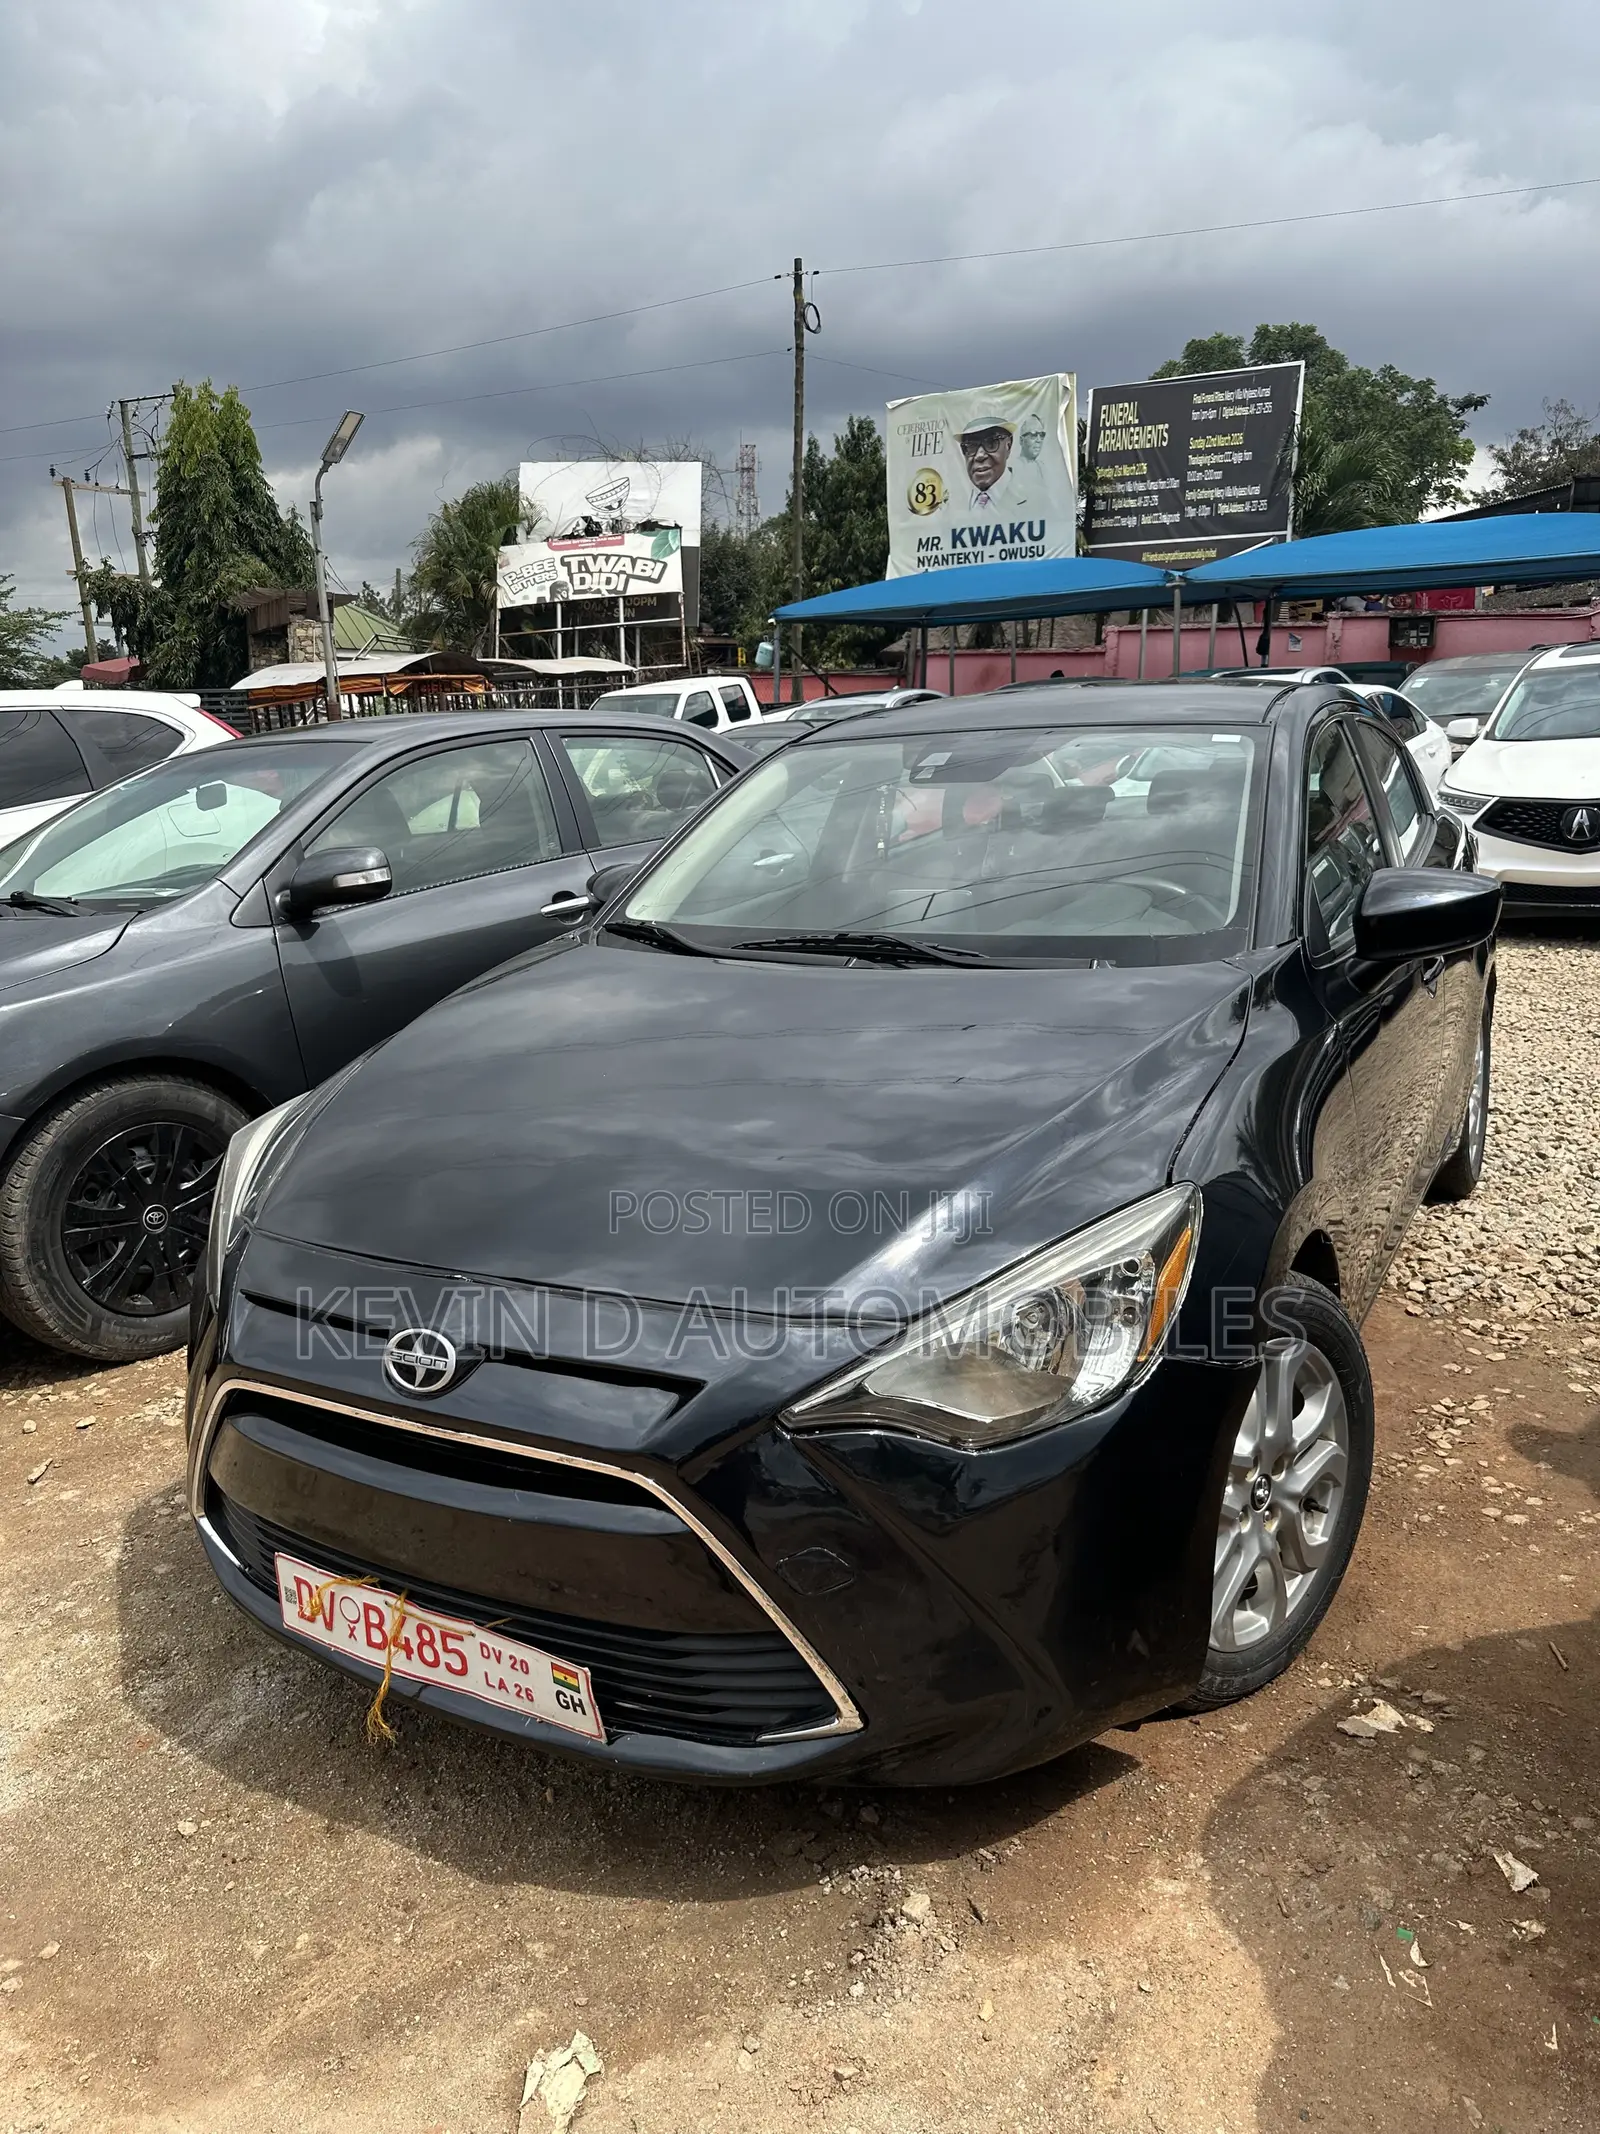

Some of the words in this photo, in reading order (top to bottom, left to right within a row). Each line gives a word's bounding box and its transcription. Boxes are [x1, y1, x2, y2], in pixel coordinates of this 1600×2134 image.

[1100, 402, 1139, 427] FUNERAL
[912, 431, 943, 457] LIFE
[1097, 423, 1169, 452] ARRANGEMENTS
[915, 482, 936, 506] 83
[917, 536, 943, 552] MR.
[951, 520, 1046, 549] KWAKU
[561, 554, 667, 584] TWABI
[917, 550, 984, 568] NYANTEKYI
[999, 545, 1045, 561] OWUSU
[504, 558, 556, 586] P-BEE
[510, 570, 558, 595] BITTERS
[571, 572, 630, 595] DIDI
[390, 1351, 448, 1369] SCION
[479, 1640, 502, 1665] DV
[509, 1654, 529, 1675] 20
[484, 1671, 509, 1695] LA
[514, 1681, 534, 1703] 26
[555, 1689, 587, 1716] GH
